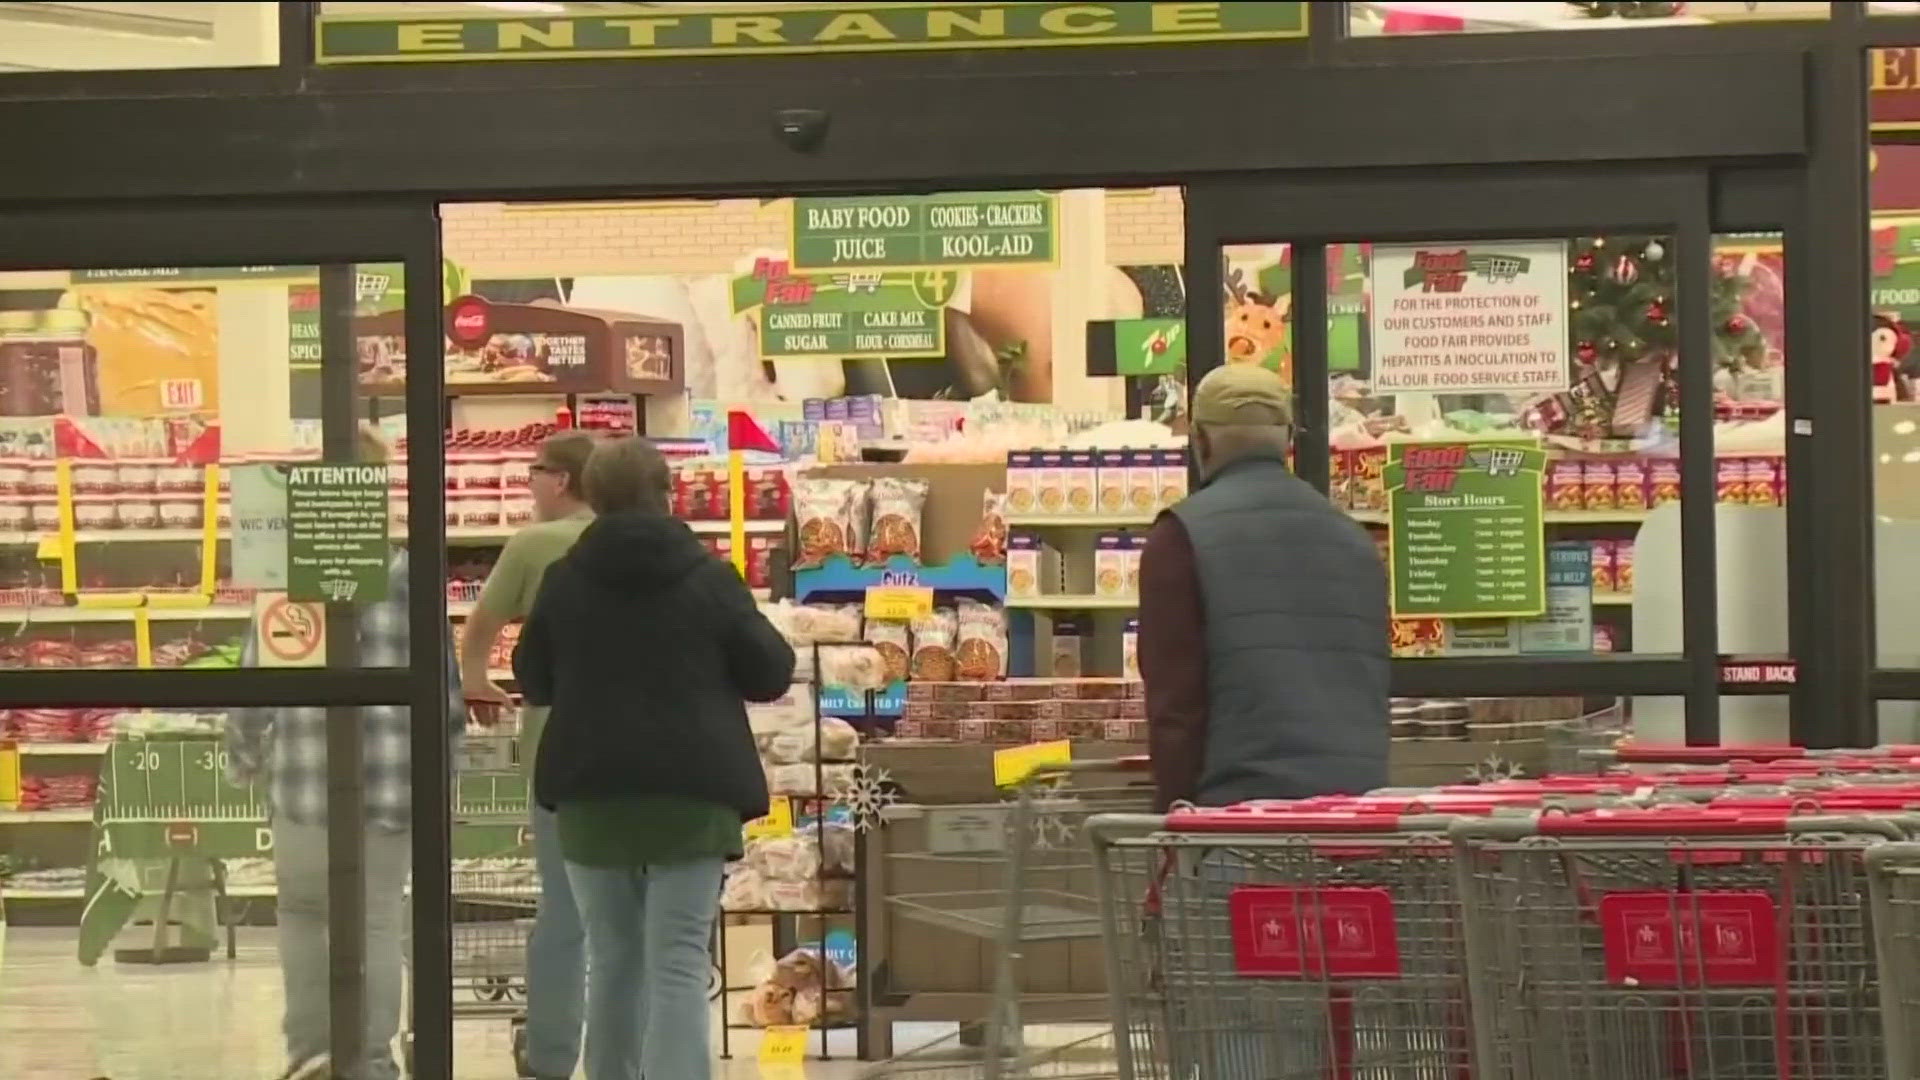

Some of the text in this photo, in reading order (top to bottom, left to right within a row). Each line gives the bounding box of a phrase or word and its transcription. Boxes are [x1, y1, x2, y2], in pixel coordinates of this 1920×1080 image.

[398, 2, 1222, 51] ENTRANCE
[808, 206, 910, 230] BABY FOOD
[931, 203, 1043, 228] COOKIES CRACKERS
[833, 238, 886, 262] JUICE
[942, 235, 1033, 258] KOOL-AID
[923, 271, 948, 302] 4
[1393, 295, 1541, 311] FOR THE PROTECTION OF
[769, 312, 843, 329] CANNED FRUIT
[863, 311, 925, 327] CAKE MIX
[1383, 313, 1552, 331] OUR CUSTOMERS AND STAFF
[784, 335, 829, 350] SUGAR
[1404, 333, 1531, 348] FOOD FAIR PROVIDES
[1382, 351, 1557, 368] HEPATITIS A INOCULATION TO
[1379, 373, 1400, 387] ALL
[1402, 373, 1428, 386] OUR
[1433, 372, 1469, 385] FOOD
[1471, 371, 1520, 385] SERVICE
[167, 381, 195, 405] EXIT
[289, 467, 387, 485] ATTENTION
[1424, 493, 1505, 507] Store Hours
[240, 518, 263, 531] WIC
[1723, 666, 1797, 683] STAND BACK
